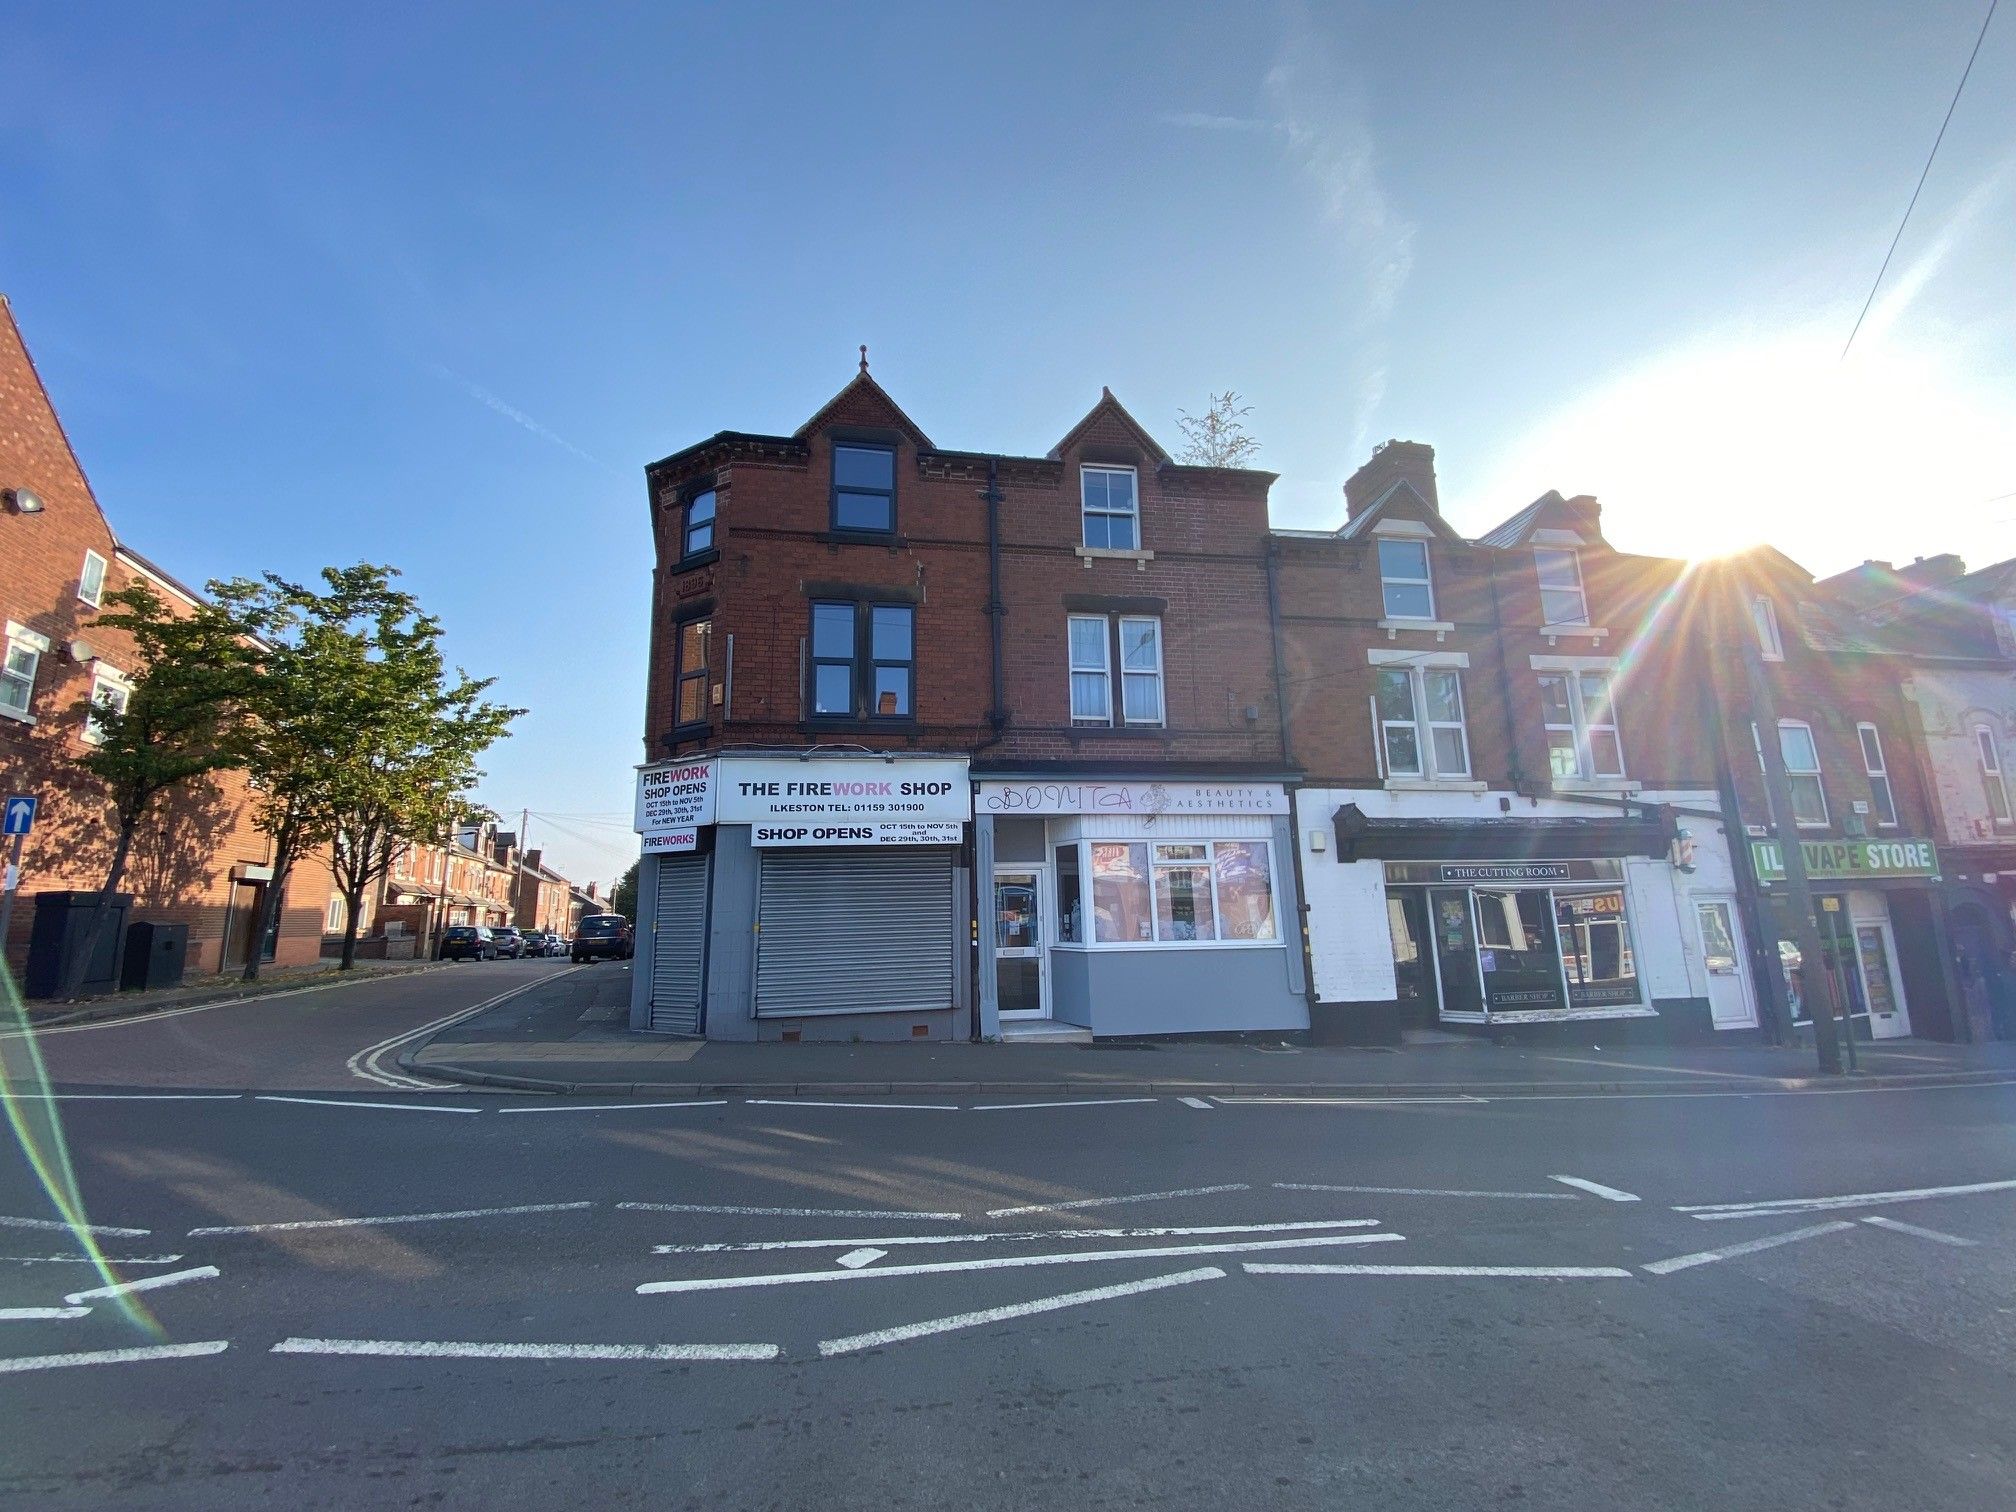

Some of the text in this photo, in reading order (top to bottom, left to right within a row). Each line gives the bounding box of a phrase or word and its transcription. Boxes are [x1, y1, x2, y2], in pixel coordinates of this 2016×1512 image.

[643, 765, 710, 786] FIREWORK
[644, 782, 707, 799] SHOP OPENS
[739, 783, 952, 796] THE FIREWORK SHOP
[1195, 789, 1272, 797] BEAUTY &
[646, 801, 658, 809] OCT
[680, 797, 693, 805] NOV
[770, 803, 925, 812] ILKESTON TEL: 01159 301900
[1177, 800, 1272, 808] AESTHETICS
[757, 827, 873, 840] SHOP OPENS
[644, 834, 694, 847] FIREWORKS
[1805, 845, 1861, 870] VAPE
[1866, 843, 1932, 869] STORE
[1455, 867, 1558, 878] THE CUTTING ROOM
